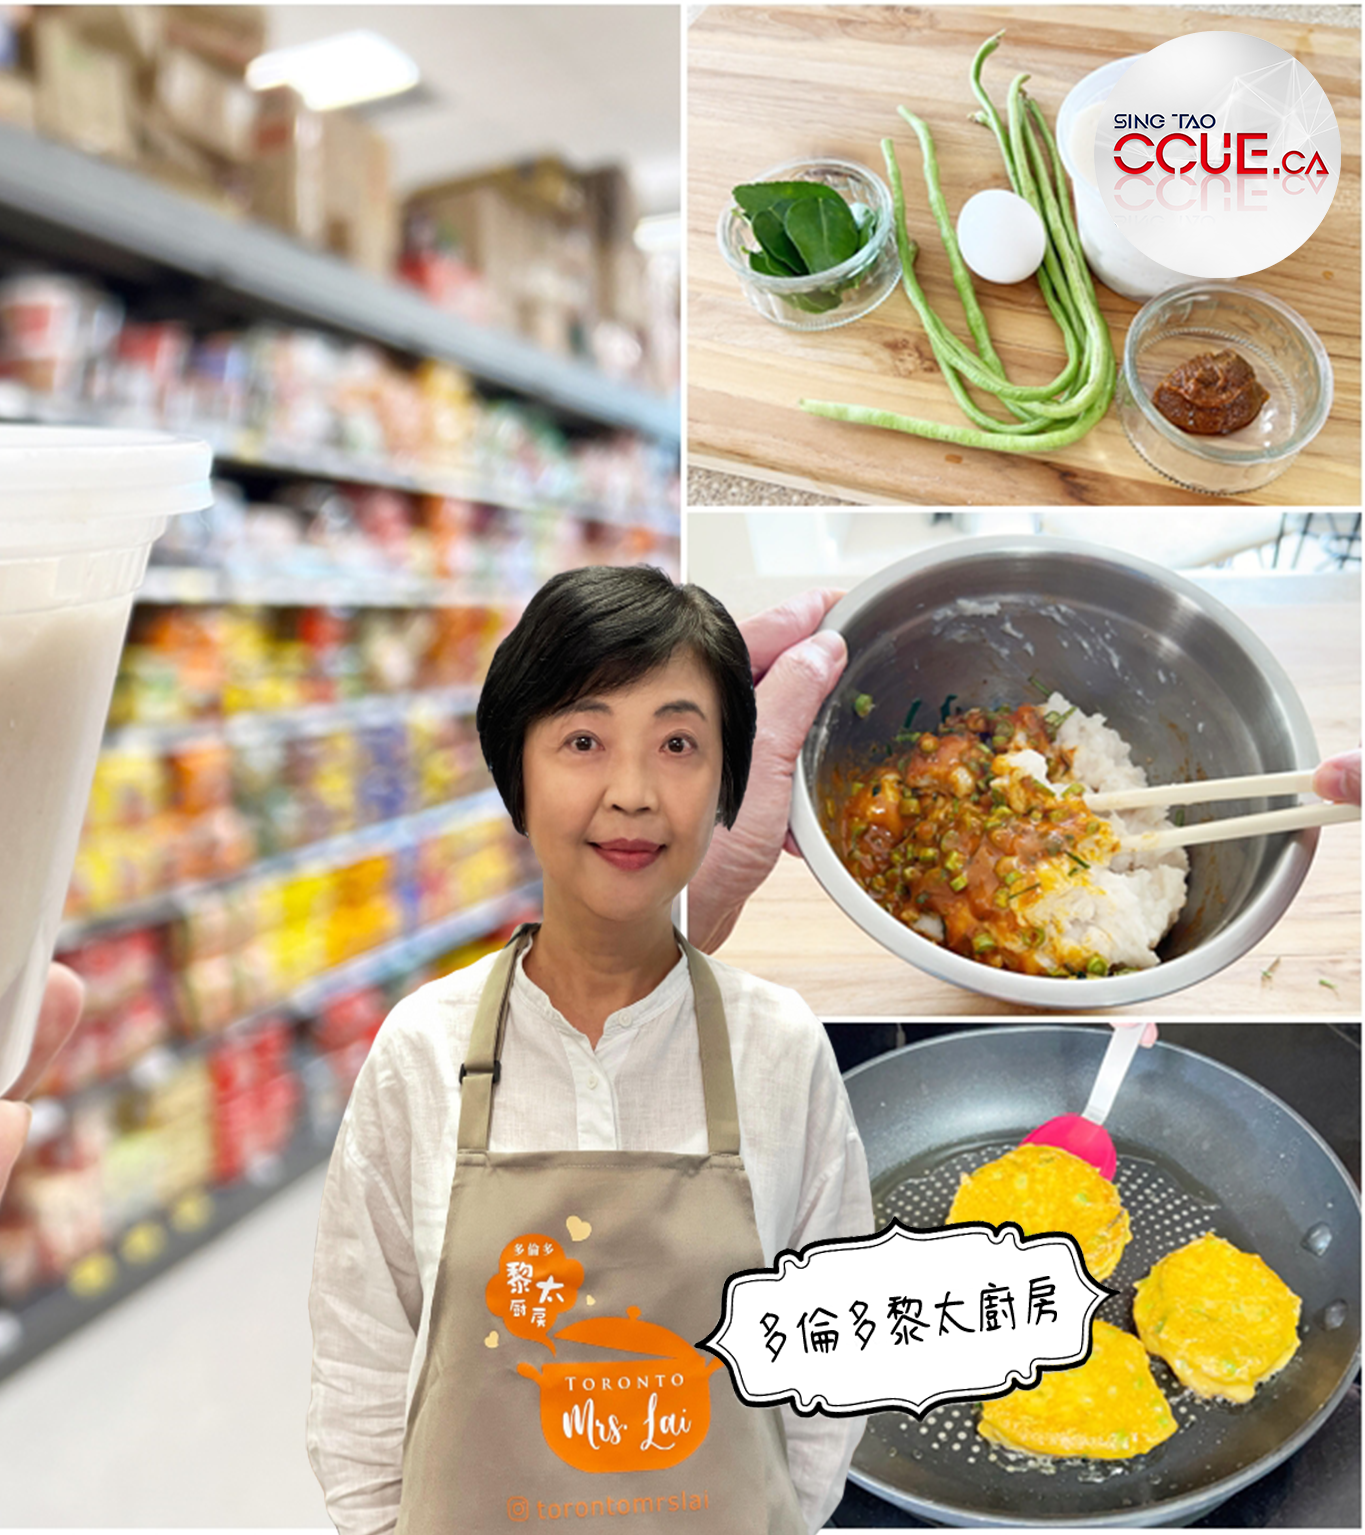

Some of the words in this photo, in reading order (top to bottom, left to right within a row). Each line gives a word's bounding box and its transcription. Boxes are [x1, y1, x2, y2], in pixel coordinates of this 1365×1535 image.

[513, 1242, 554, 1257] 多倫多
[505, 1261, 565, 1304] 黎太
[564, 1373, 685, 1392] TORONTO
[562, 1397, 629, 1450] Mrs.
[640, 1392, 692, 1451] Lai
[536, 1490, 710, 1520] torontomrslai
